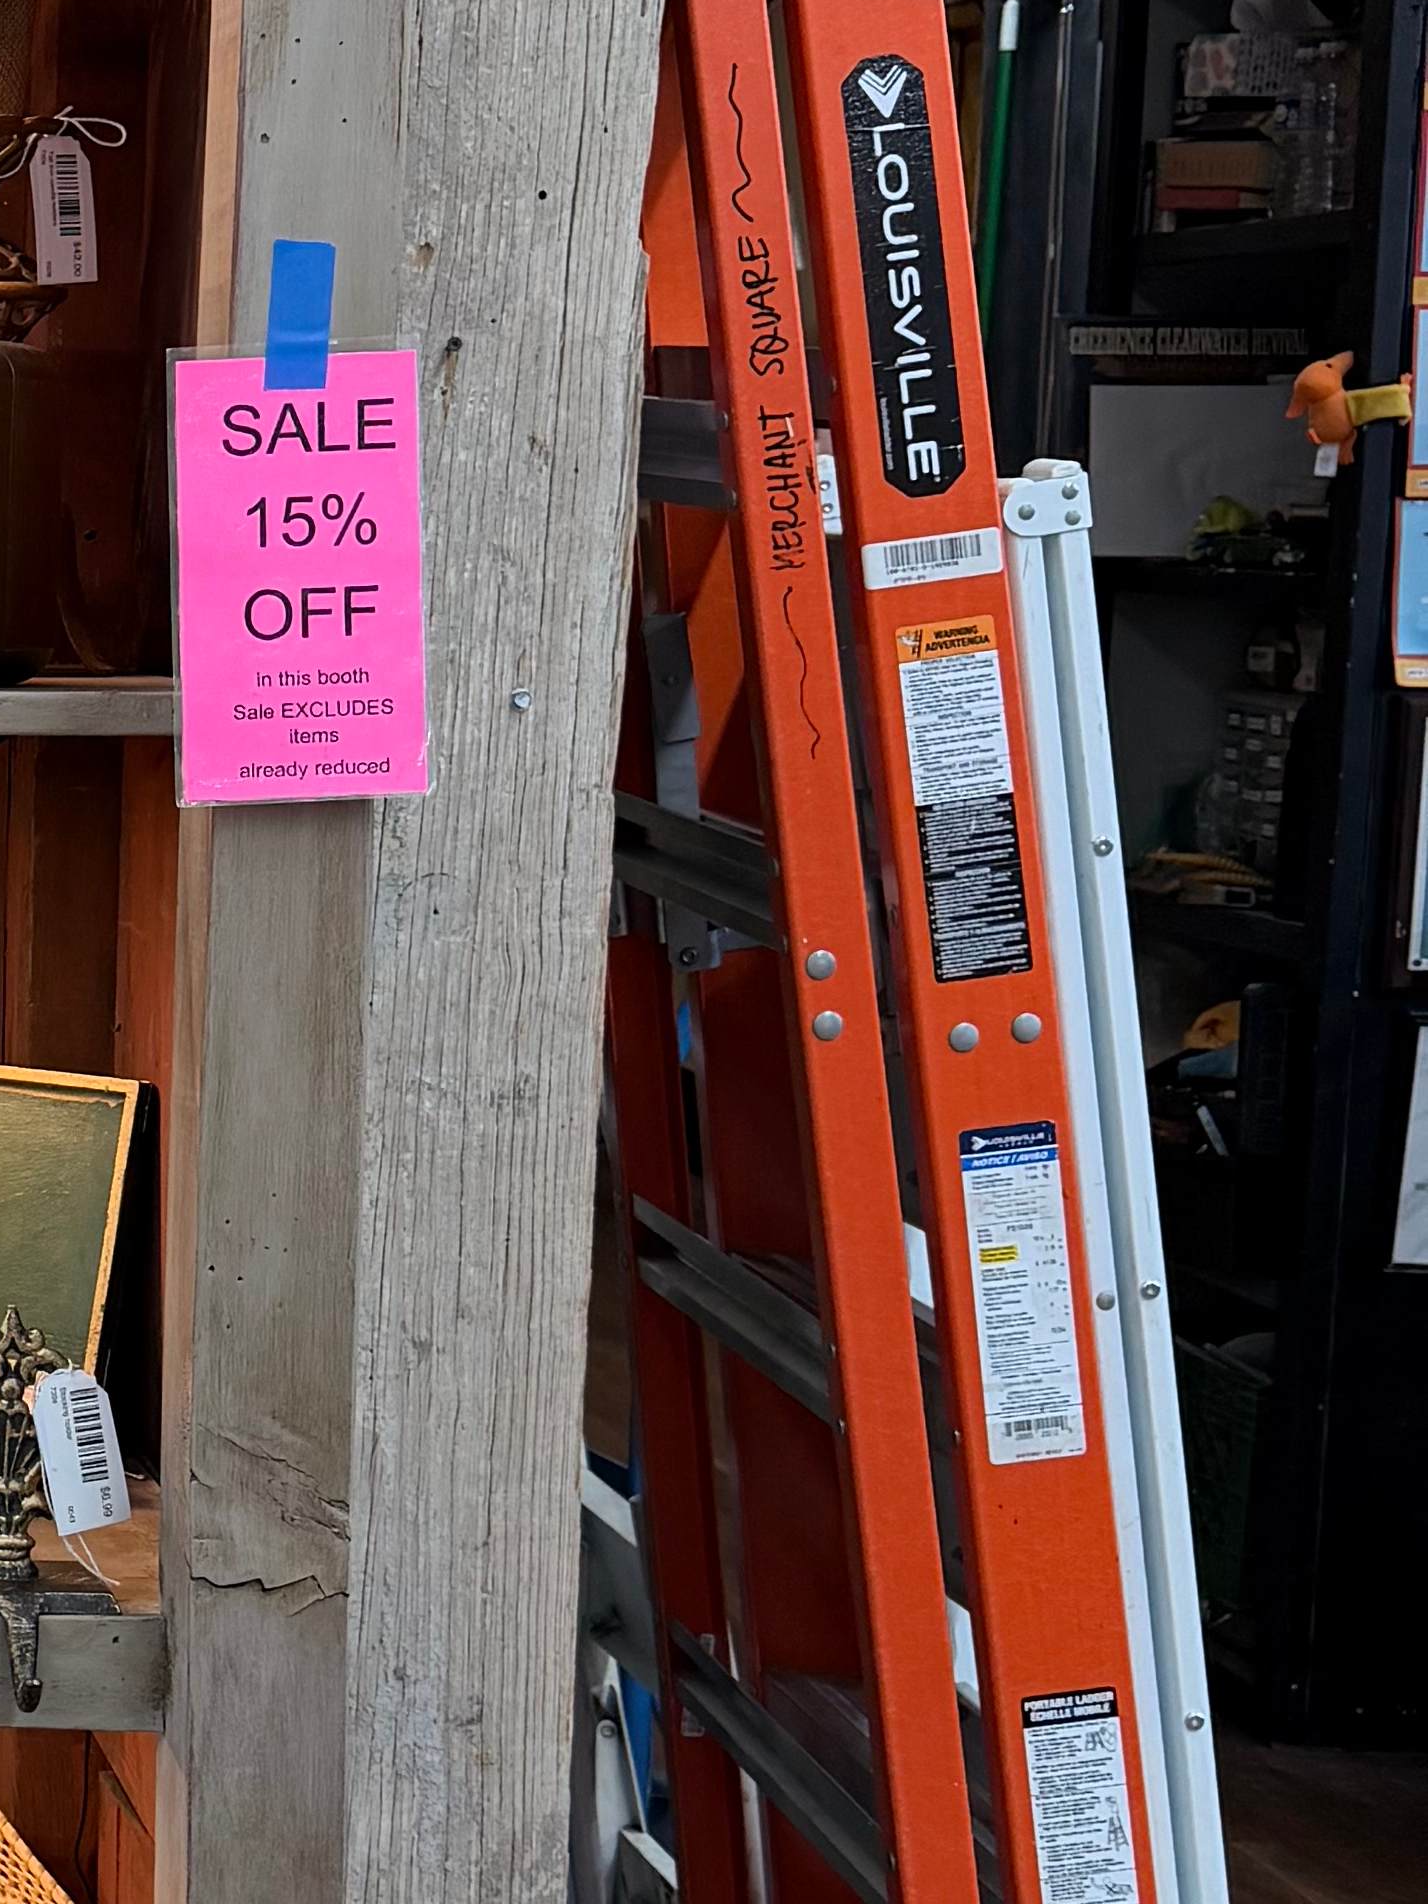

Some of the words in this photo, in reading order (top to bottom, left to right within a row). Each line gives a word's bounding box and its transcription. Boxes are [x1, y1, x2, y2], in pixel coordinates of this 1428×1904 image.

[737, 234, 789, 377] SQUARE
[874, 122, 942, 483] LOUISVILLE
[222, 398, 397, 456] SALE
[758, 405, 807, 573] MERCHANT
[246, 492, 378, 549] 15%
[244, 584, 379, 642] OFF
[256, 671, 274, 688] in
[277, 668, 312, 686] this
[317, 667, 370, 686] booth
[233, 704, 275, 722] Sale
[281, 698, 394, 720] EXCLUDES
[289, 726, 339, 745] items
[239, 760, 310, 780] already
[314, 757, 391, 777] reduced
